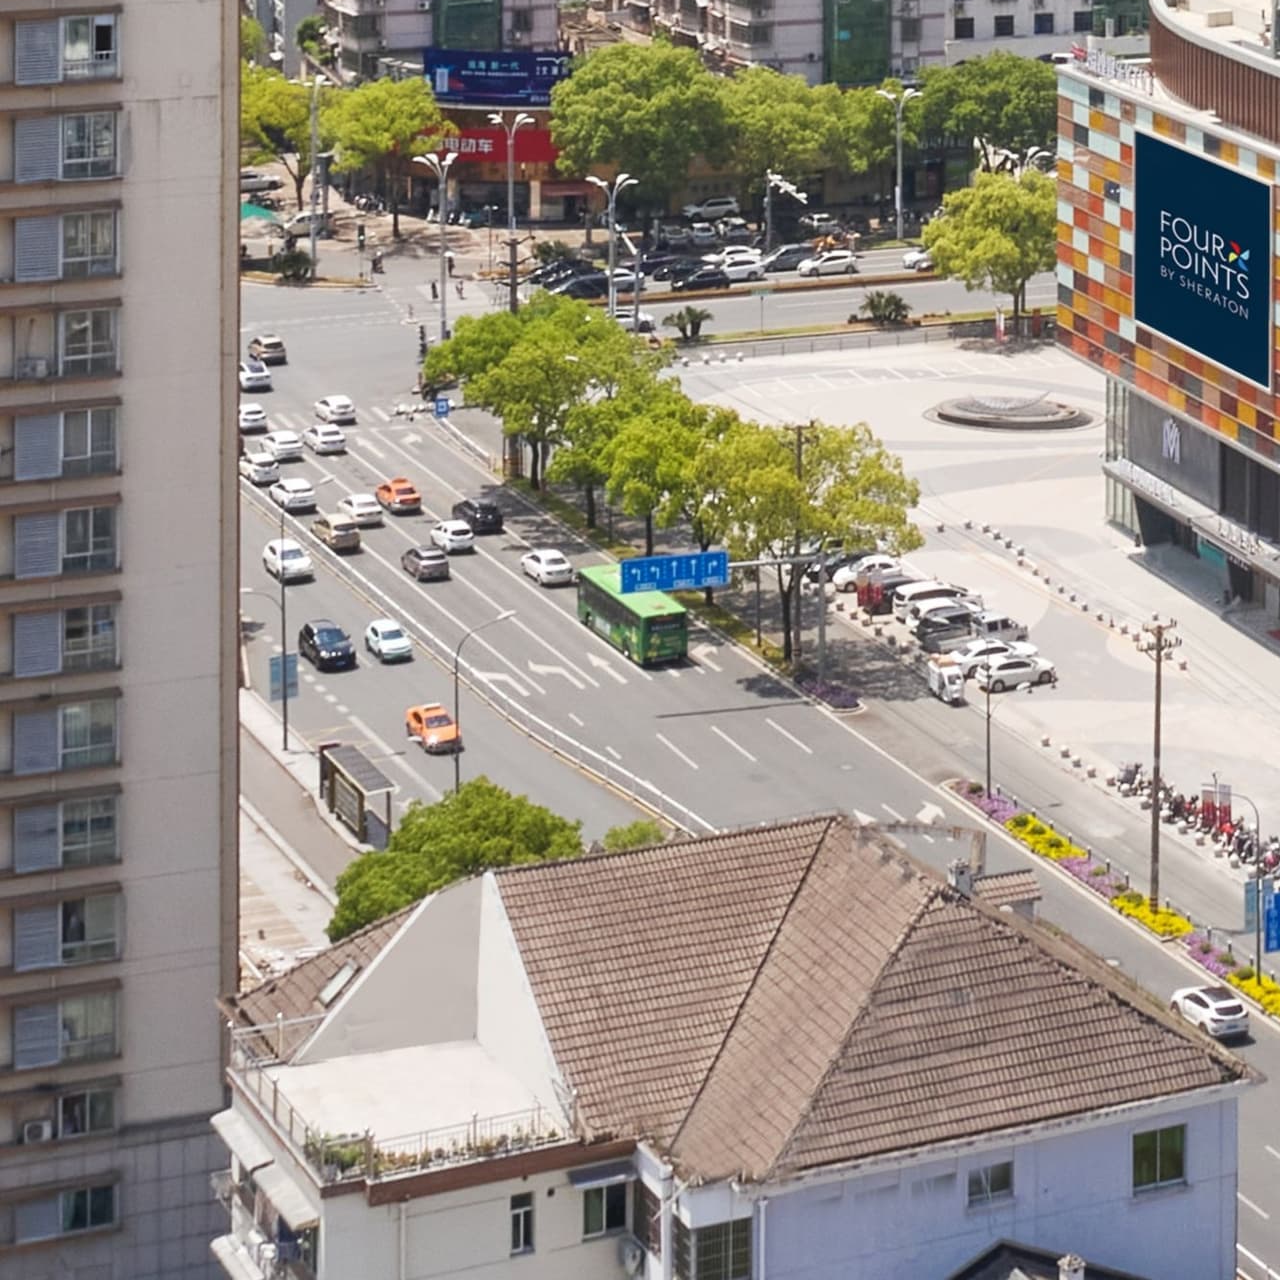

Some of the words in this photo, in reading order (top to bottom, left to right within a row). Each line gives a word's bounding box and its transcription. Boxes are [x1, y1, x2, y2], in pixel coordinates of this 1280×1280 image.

[1160, 209, 1228, 262] FOUR
[1160, 236, 1250, 300] POINTS
[1160, 265, 1175, 281] BY
[1179, 274, 1249, 320] SHERATON
